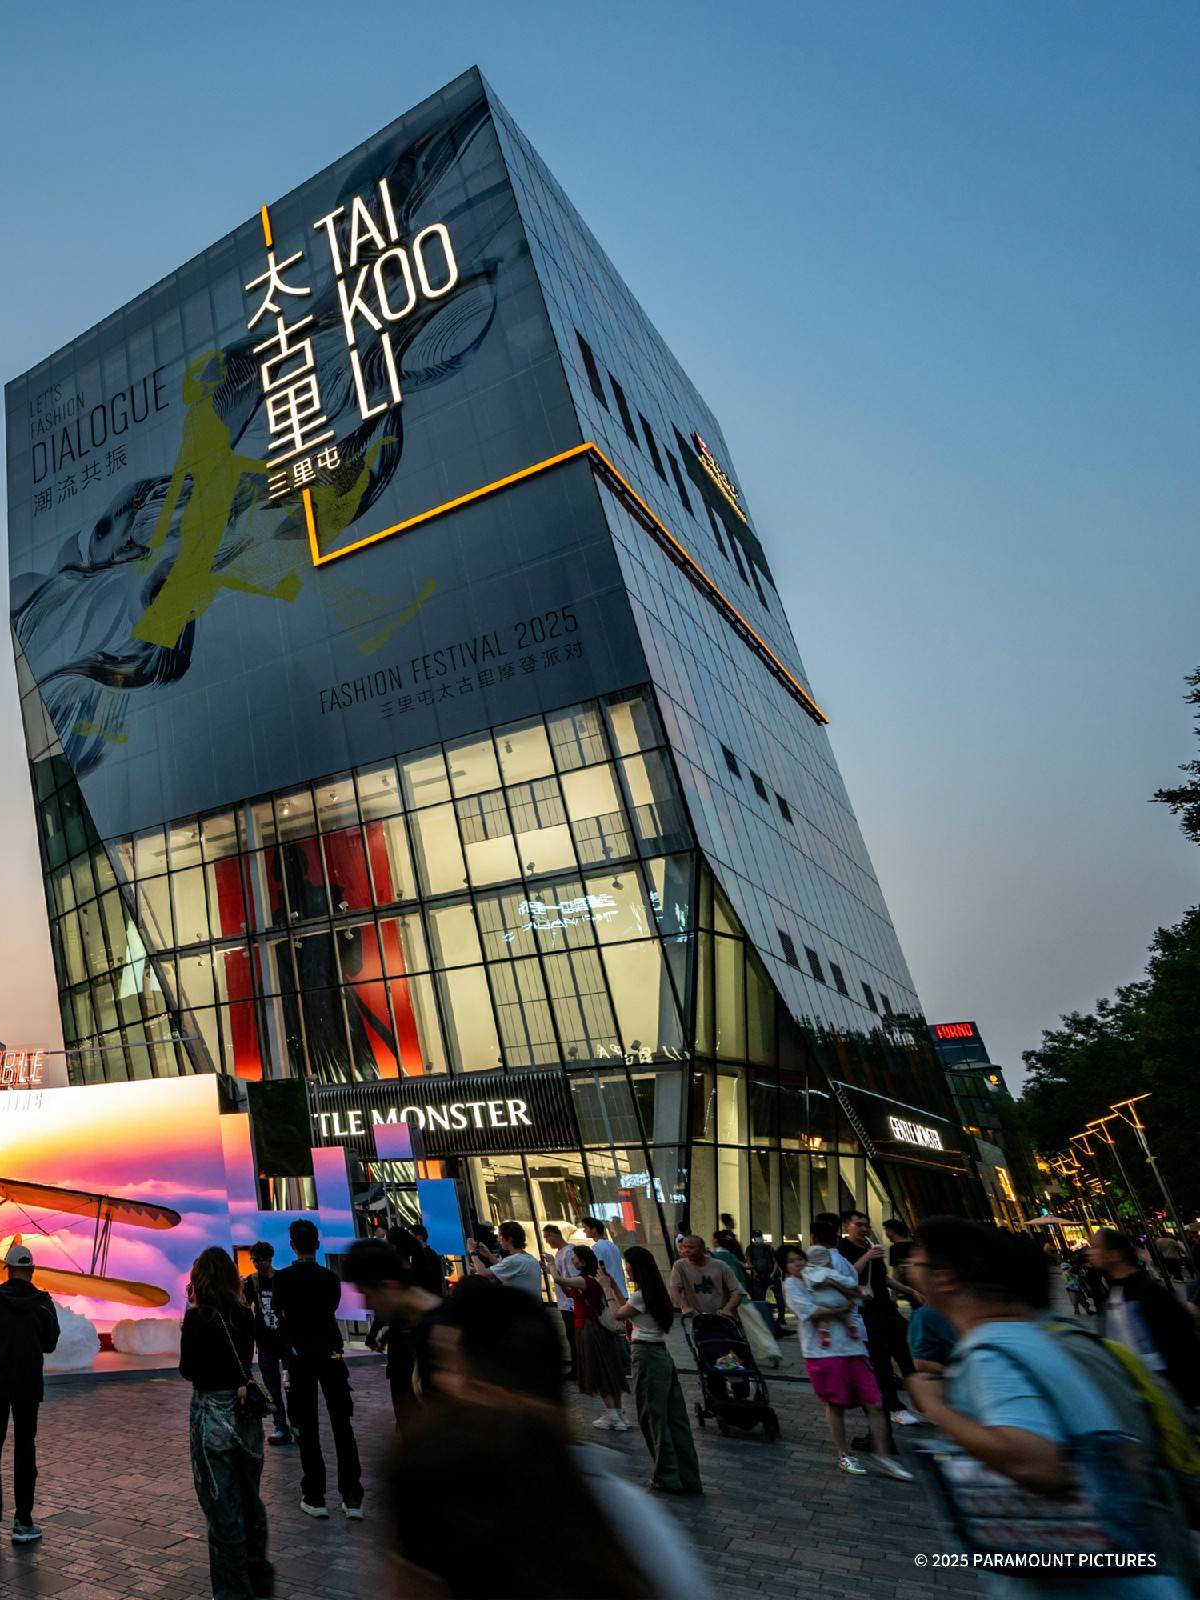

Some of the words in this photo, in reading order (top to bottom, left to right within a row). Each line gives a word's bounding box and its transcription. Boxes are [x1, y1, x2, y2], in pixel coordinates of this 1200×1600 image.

[313, 178, 399, 276] TAI
[338, 223, 460, 347] KOO
[246, 251, 335, 468] 太古里
[351, 332, 402, 420] LI
[31, 391, 85, 440] FASHION
[32, 365, 169, 485] DIALOGUE
[33, 443, 128, 516] 潮流共振
[268, 446, 340, 500] 三里屯
[319, 665, 403, 714] FASHION
[410, 631, 507, 684] FESTIVAL
[514, 604, 579, 650] 2025
[379, 640, 584, 719] 三里屯太古里摩登派对
[371, 1099, 532, 1131] MONSTER
